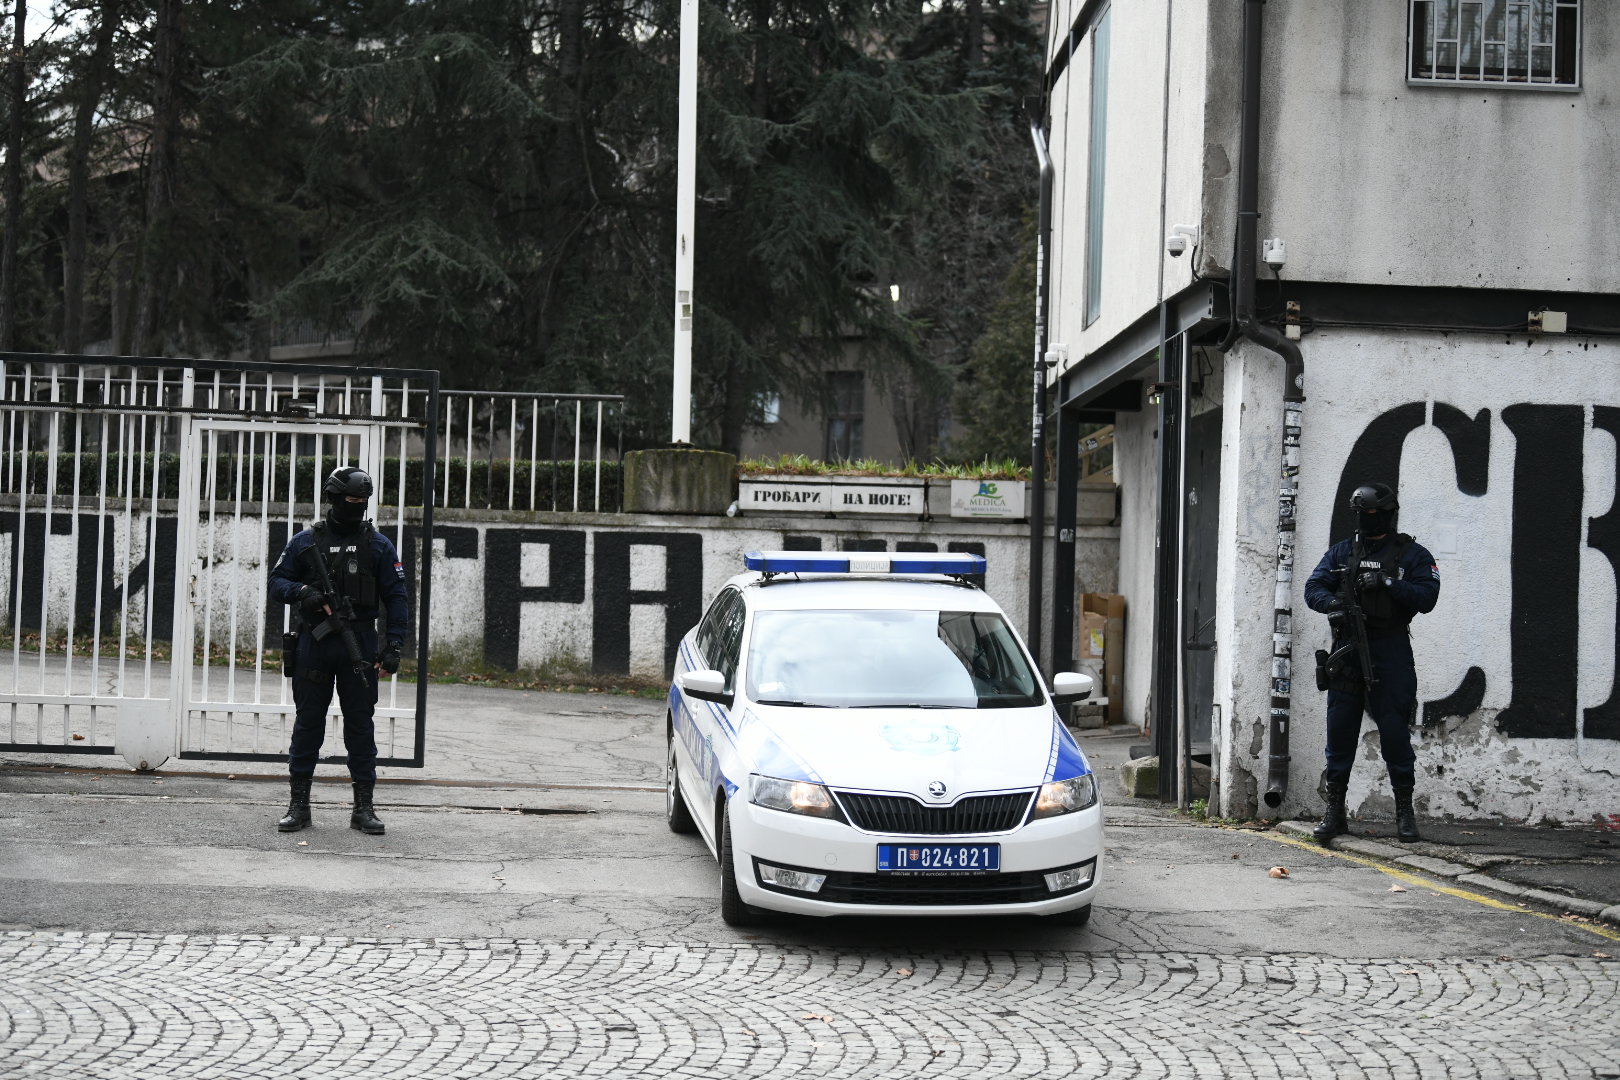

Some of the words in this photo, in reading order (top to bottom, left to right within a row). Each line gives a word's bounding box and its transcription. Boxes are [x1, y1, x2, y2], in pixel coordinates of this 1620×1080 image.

[978, 483, 998, 494] AG
[753, 490, 821, 504] ГРОБАРИ
[842, 493, 864, 505] НА
[868, 493, 911, 506] НОГЕ!
[969, 498, 1006, 506] MEDICA
[897, 847, 907, 867] П
